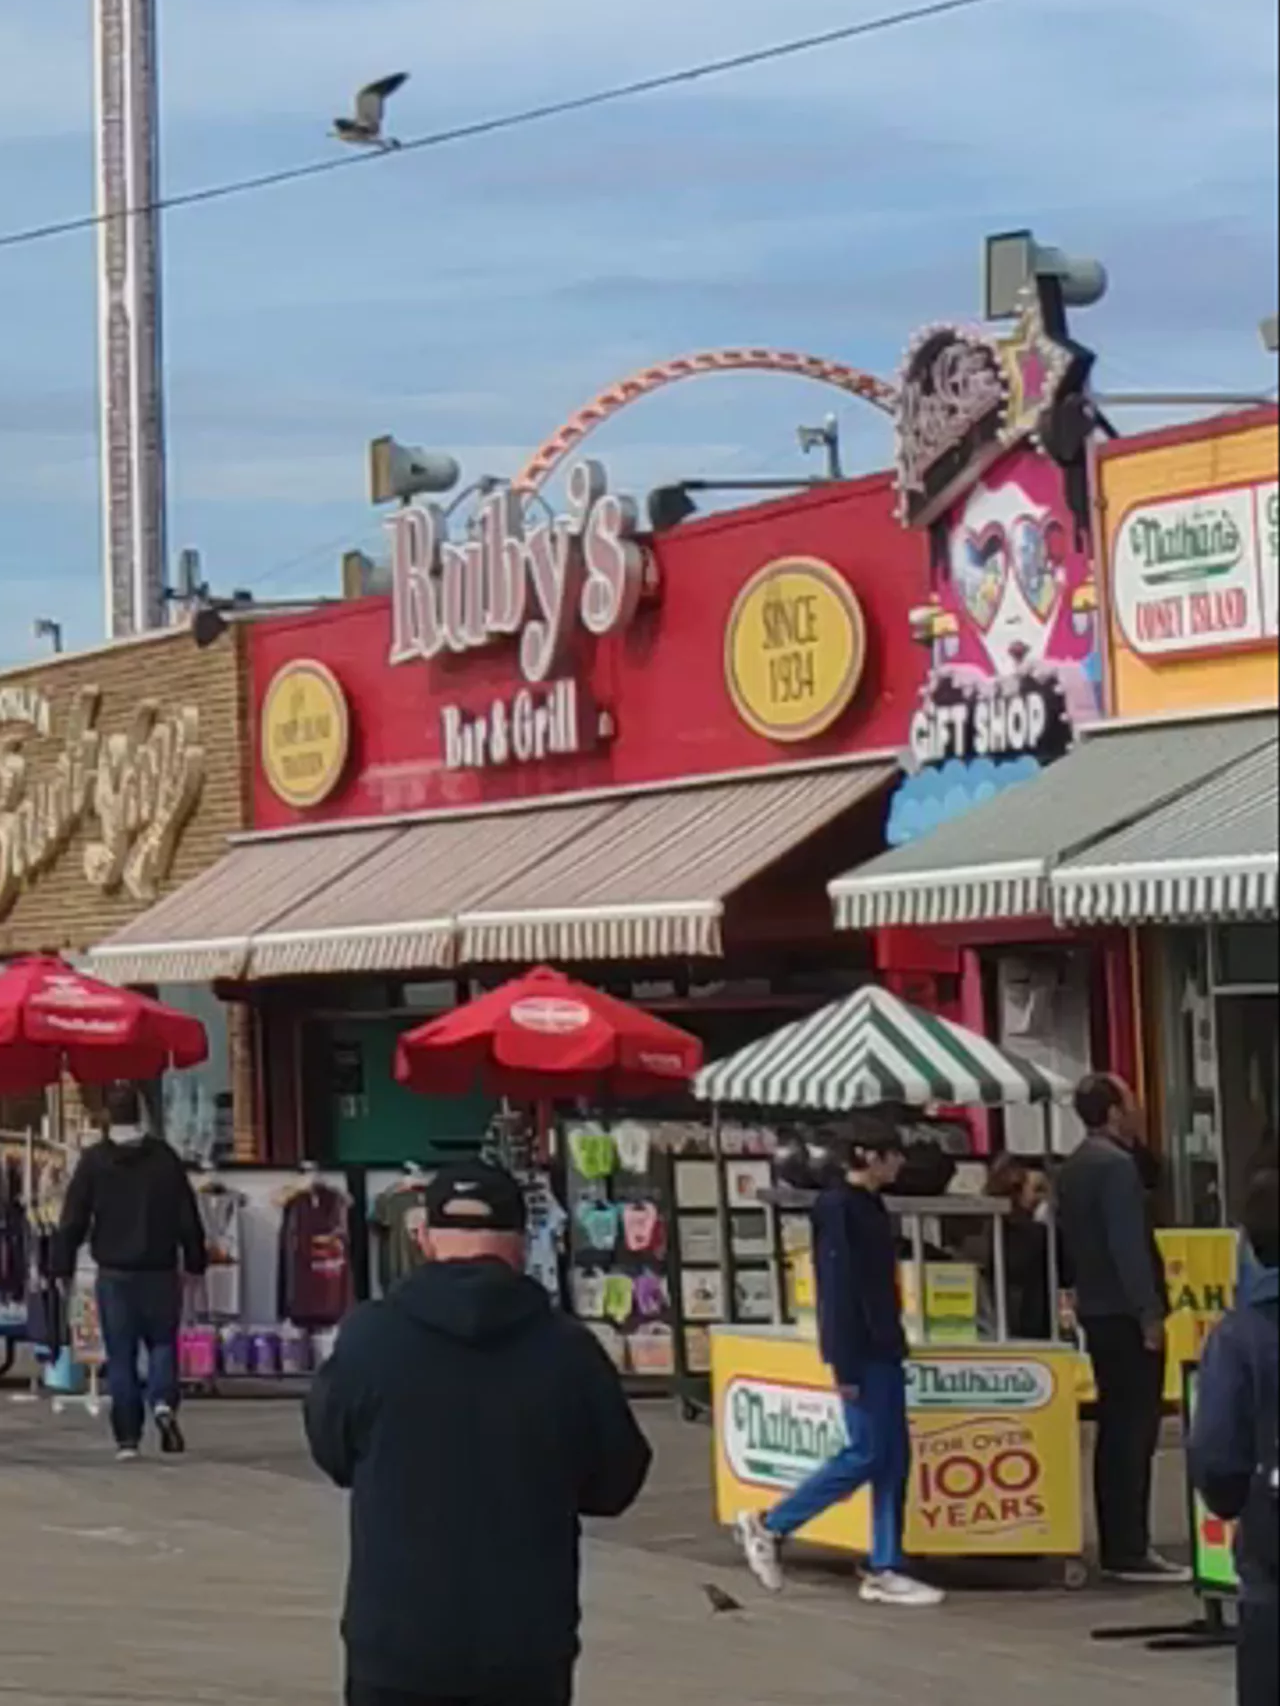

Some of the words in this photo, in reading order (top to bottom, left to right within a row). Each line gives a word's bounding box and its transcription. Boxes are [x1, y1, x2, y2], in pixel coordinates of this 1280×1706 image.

[1130, 509, 1240, 567] Nathan's
[384, 459, 624, 680] Ruby's
[762, 596, 817, 649] SINCE
[769, 649, 815, 703] 1934
[513, 678, 576, 761] Grill
[973, 694, 1044, 754] SHOP
[972, 1430, 1034, 1450] OVER
[920, 1450, 1039, 1503] 100
[921, 1495, 1045, 1529] YEARS
